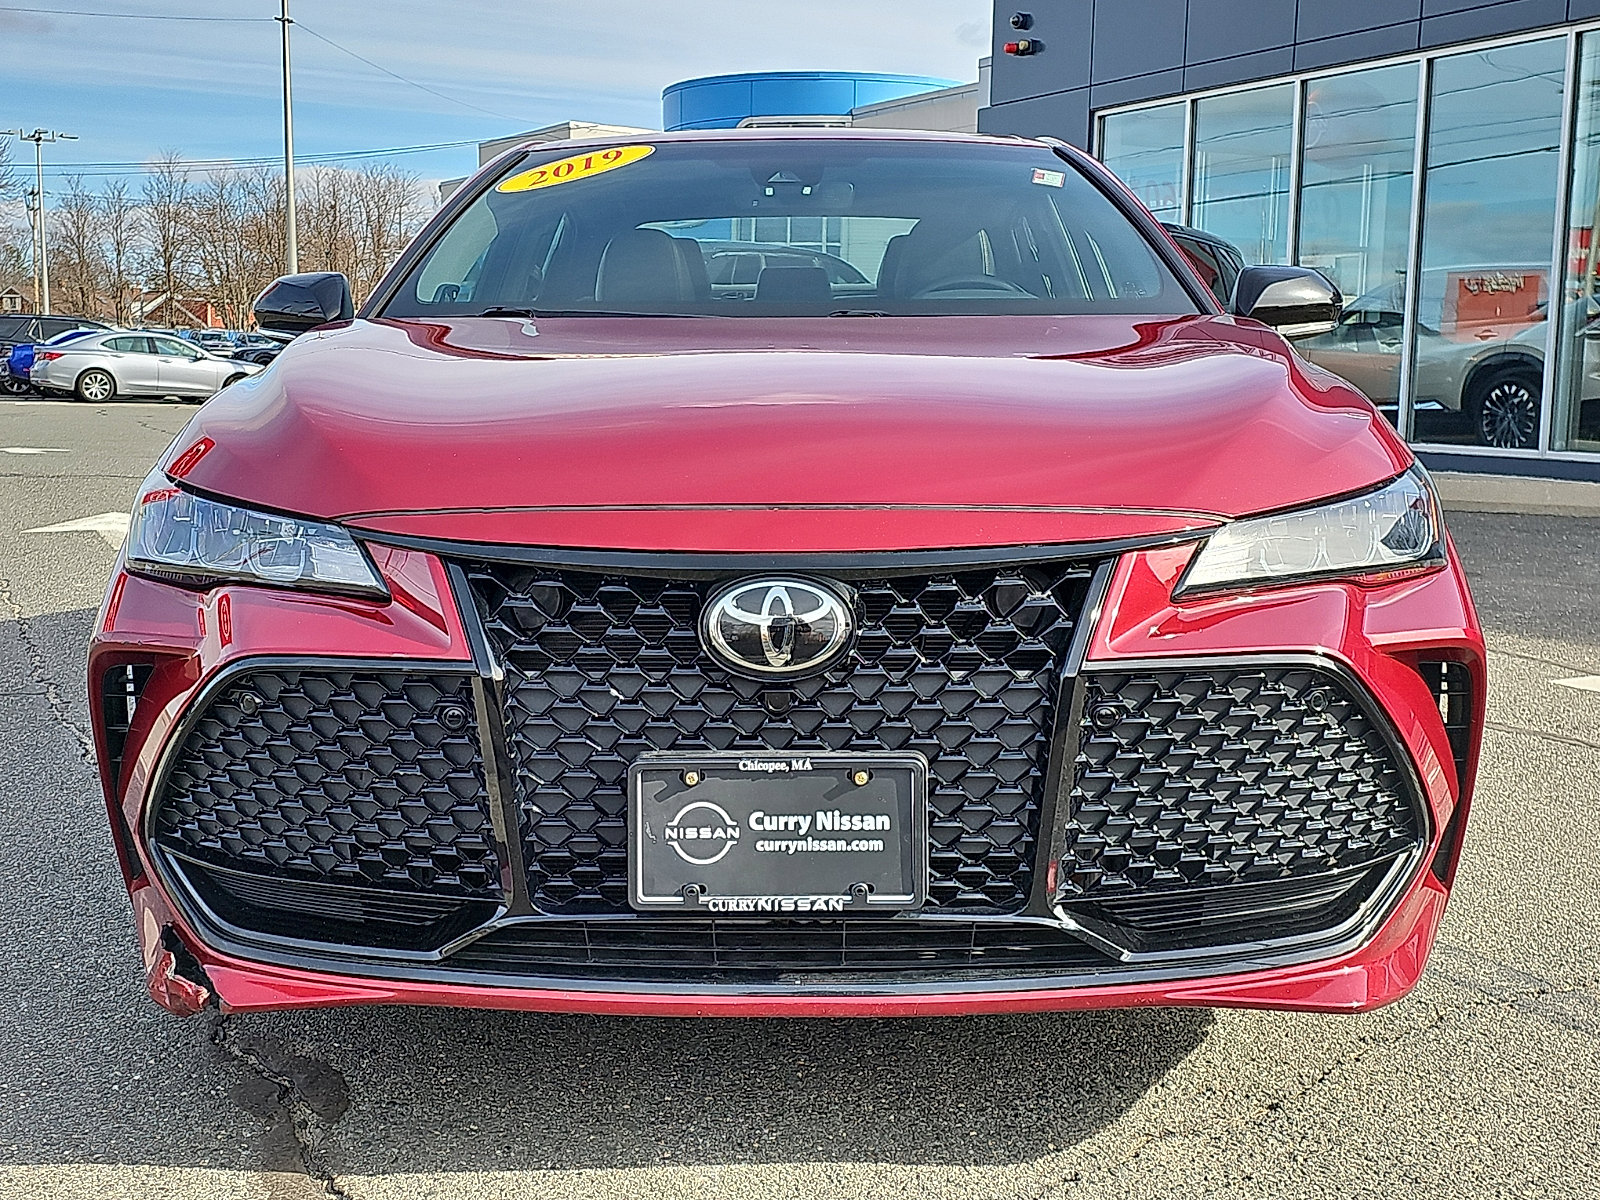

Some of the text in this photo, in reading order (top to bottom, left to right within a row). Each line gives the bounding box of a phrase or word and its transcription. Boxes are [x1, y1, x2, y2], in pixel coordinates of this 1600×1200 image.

[528, 149, 623, 187] 2019
[738, 757, 813, 774] Chicopee, MA
[748, 809, 891, 835] Curry Nissan
[664, 827, 741, 840] NISSAN
[755, 836, 884, 854] currynissan.com
